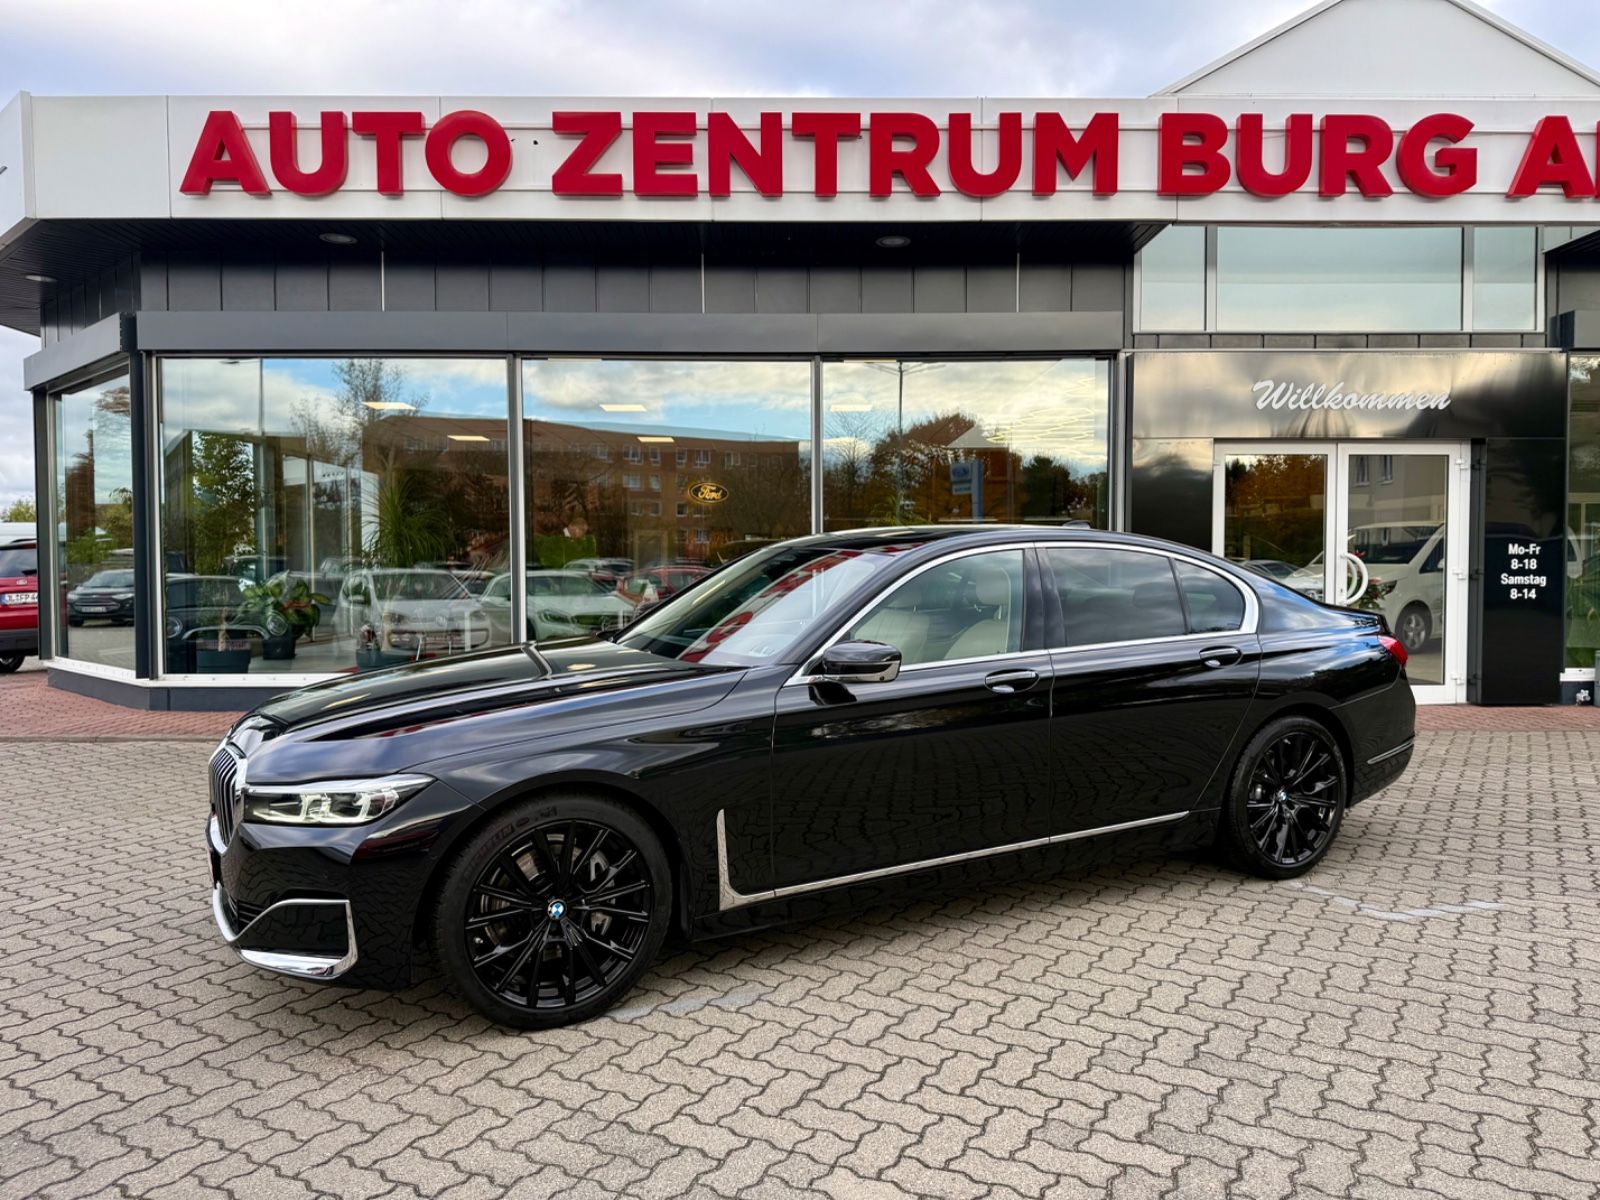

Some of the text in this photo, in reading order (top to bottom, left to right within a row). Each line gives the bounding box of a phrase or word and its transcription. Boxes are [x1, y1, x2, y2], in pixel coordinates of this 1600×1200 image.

[180, 111, 1600, 199] AUTO ZENTRUM BURG A
[1253, 380, 1451, 410] Willkommen
[1508, 543, 1541, 555] Mo-Fr
[1511, 558, 1537, 569] 8-18
[1500, 572, 1547, 587] Samstag
[1510, 588, 1537, 599] 8-14
